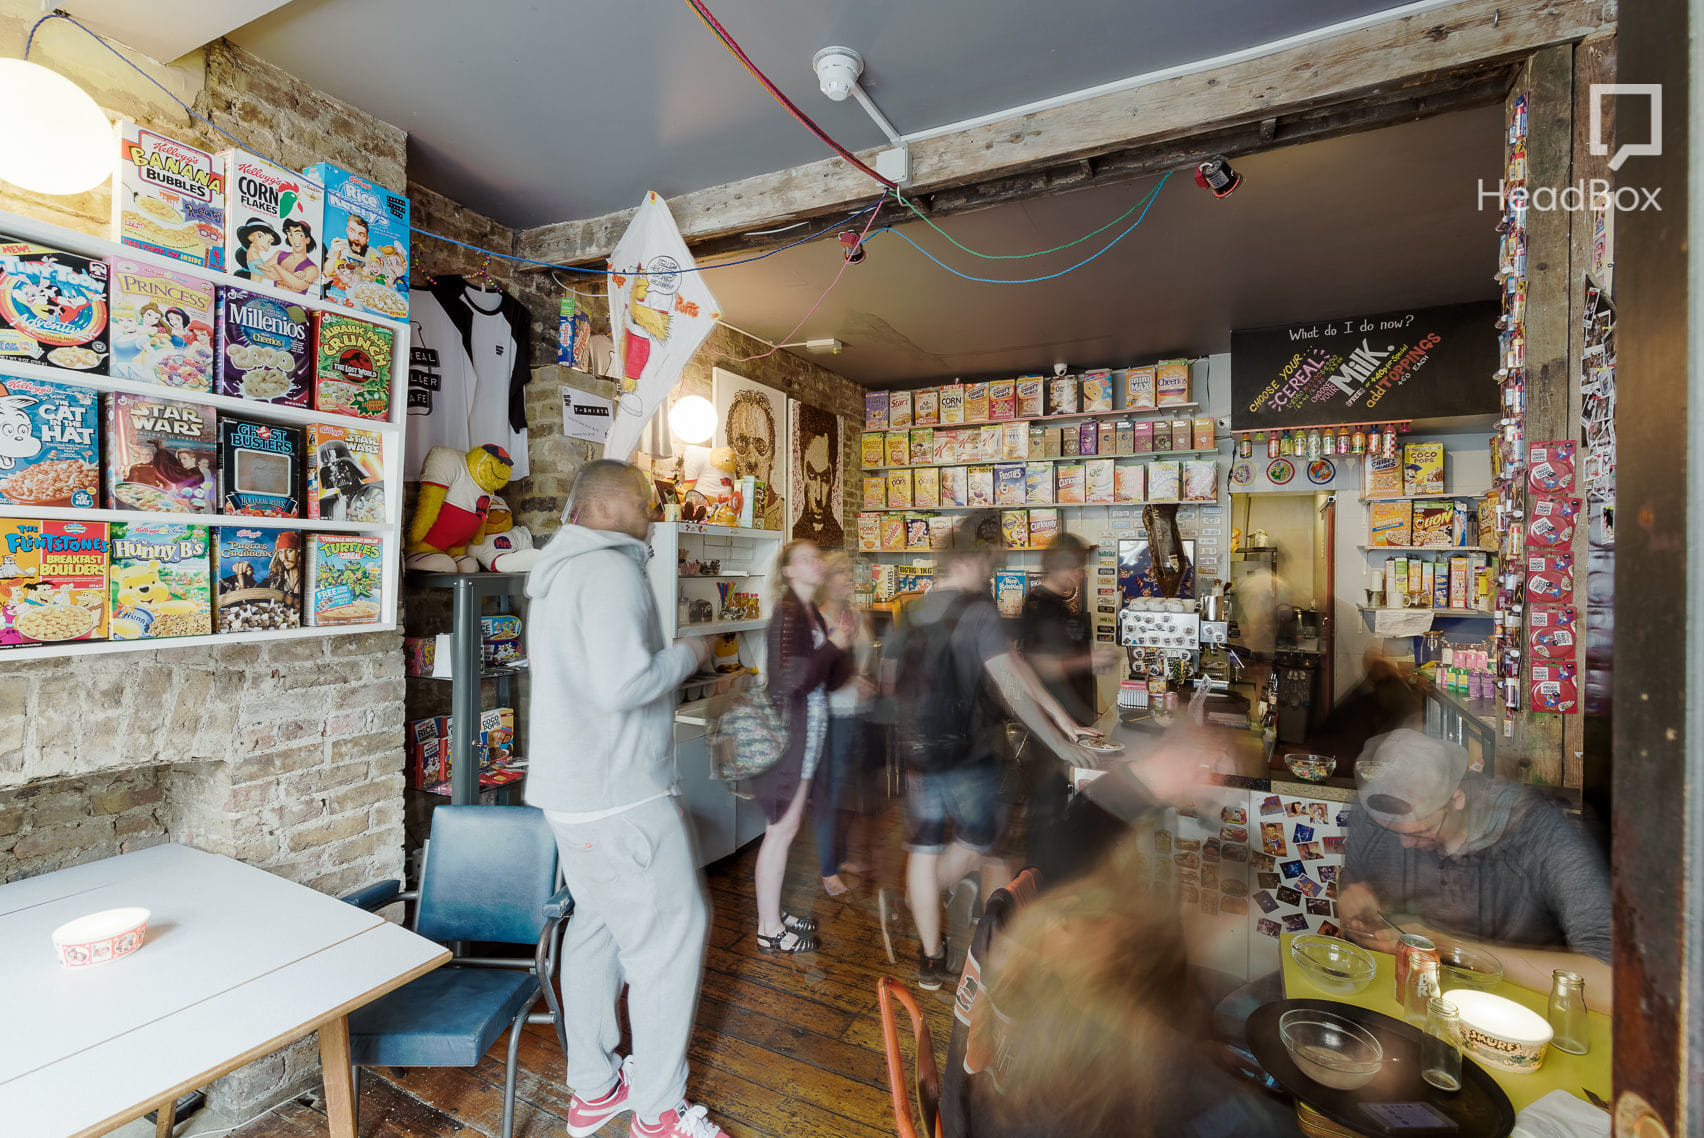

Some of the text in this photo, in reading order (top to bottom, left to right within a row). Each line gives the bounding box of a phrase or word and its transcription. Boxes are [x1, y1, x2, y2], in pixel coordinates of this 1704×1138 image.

[128, 146, 221, 195] BANANA
[238, 163, 281, 187] Kellogg's
[146, 168, 206, 198] BUBBLES
[238, 176, 279, 207] CORN
[240, 196, 279, 216] FLAKES
[2, 244, 32, 254] NEW!
[124, 275, 206, 309] PRINCESS
[228, 303, 307, 344] Millenios
[1289, 314, 1414, 341] What do I do now?
[252, 333, 283, 350] Cheerios
[322, 333, 387, 370] CRUNCH
[1377, 332, 1441, 388] TOPPINGS
[346, 364, 359, 376] LOST
[358, 367, 377, 381] WORLD
[1412, 355, 1430, 372] EACH
[7, 379, 53, 395] Kellogg's
[1158, 377, 1188, 387] Cheerios
[1274, 358, 1325, 405] CEREAL
[941, 397, 962, 406] CORN
[1249, 379, 1280, 412] CHOOSE
[1311, 381, 1333, 403] CHOOSE
[1319, 385, 1340, 402] YOUR
[1366, 385, 1387, 408] add
[38, 404, 87, 422] CAT
[130, 402, 203, 424] STAR
[50, 419, 83, 430] IN THE
[129, 414, 204, 437] WARS
[41, 424, 95, 446] HAT
[344, 433, 380, 447] STAR
[231, 436, 293, 458] BUSTERS
[346, 440, 380, 455] WARS
[1410, 451, 1438, 459] COCO
[999, 468, 1022, 482] FROSTIES
[1424, 511, 1453, 527] LION
[16, 524, 38, 534] THE
[5, 533, 109, 554] FLINTSTONES
[115, 540, 178, 563] Hunny
[318, 542, 381, 559] TURTLES
[40, 563, 106, 576] BOULDERS
[46, 554, 102, 567] BREAKFAST
[482, 715, 499, 726] COCO
[417, 723, 436, 738] RICE
[1470, 1028, 1523, 1054] SMURFS
